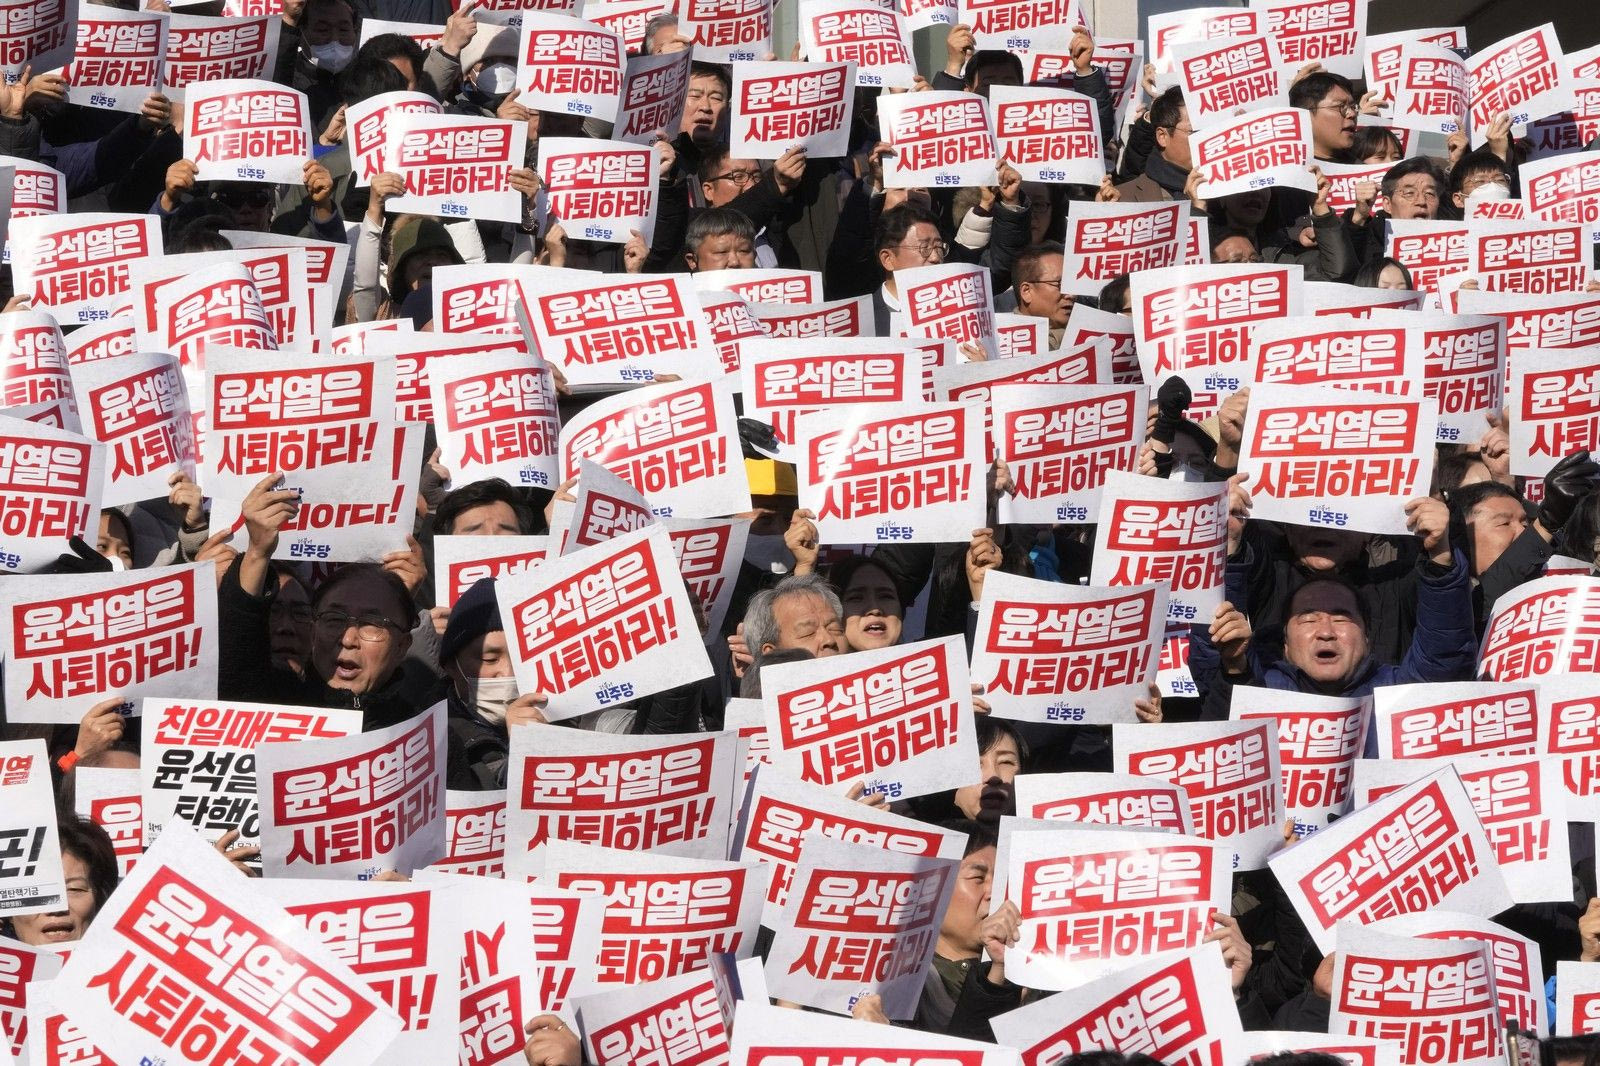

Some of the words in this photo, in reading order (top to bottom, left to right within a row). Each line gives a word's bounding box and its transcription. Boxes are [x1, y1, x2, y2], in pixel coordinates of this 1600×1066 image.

[8, 1, 59, 33] 열은
[819, 13, 897, 42] 윤석열은
[972, 0, 1069, 34] 사퇴하라!
[1268, 2, 1350, 32] 윤석열은
[1, 23, 69, 65] 하라!
[77, 23, 157, 52] 윤석열은
[168, 25, 259, 58] 윤석열은
[534, 34, 618, 64] 윤석열은
[826, 42, 911, 66] 사퇴하라!
[1007, 39, 1031, 48] 민주당
[63, 60, 160, 86] 사퇴하라!
[528, 68, 623, 95] 사퇴하라!
[859, 76, 882, 84] 민주당
[1189, 43, 1265, 85] 윤석열은
[90, 94, 116, 107] 민주당
[567, 102, 592, 114] 민주당
[748, 71, 841, 110] 윤석열은
[1199, 71, 1279, 115] 사퇴하라!
[1407, 92, 1468, 116] 사퇴하
[198, 94, 299, 130] 윤석열은
[745, 104, 846, 142] 사퇴하라!
[895, 100, 985, 138] 윤석열은
[1003, 101, 1092, 130] 윤석열은
[1441, 123, 1459, 132] 민주
[1513, 113, 1529, 124] 주당
[196, 129, 307, 162] 사퇴하라!
[403, 129, 504, 162] 윤석열은
[897, 135, 995, 171] 사퇴하라!
[1001, 135, 1099, 165] 사퇴하라!
[1202, 115, 1296, 158] 윤석열은
[237, 167, 265, 179] 민주당
[405, 165, 512, 195] 사퇴하라!
[551, 154, 648, 187] 윤석열은
[935, 176, 960, 184] 민주당
[1039, 171, 1065, 180] 민주당
[1207, 144, 1307, 184] 사퇴하라!
[1250, 177, 1275, 188] 민주당
[13, 174, 54, 206] 열은
[551, 190, 650, 220] 사퇴하라!
[442, 203, 468, 216] 민주당
[586, 227, 612, 239] 민주당
[1080, 210, 1173, 248] 윤석열은
[1399, 234, 1468, 262] 윤석열
[34, 224, 141, 274] 윤석열은
[1484, 232, 1576, 265] 윤석열은
[31, 263, 131, 308] 사퇴하
[1486, 266, 1585, 293] 사퇴하라!
[78, 310, 109, 321] 민주당
[175, 284, 267, 338] 윤석열
[448, 282, 520, 331] 윤석
[548, 283, 674, 330] 윤석열은
[1150, 276, 1280, 334] 윤석열은
[564, 320, 697, 367] 사퇴하라!
[1000, 329, 1031, 358] 열은
[1508, 307, 1600, 348] 석열은
[1155, 326, 1251, 377] 사퇴하
[1261, 334, 1397, 383] 윤석열은
[1424, 329, 1495, 372] 석열은
[620, 368, 654, 381] 민주당
[764, 358, 895, 401] 윤석열은
[1205, 378, 1240, 390] 민주당
[1531, 371, 1600, 415] 윤석
[218, 370, 363, 421] 윤석열은
[1424, 373, 1500, 415] 퇴하라!
[570, 391, 702, 463] 윤석열은
[1013, 403, 1128, 454] 윤석열은
[1260, 409, 1407, 455] 윤석열은
[1436, 428, 1460, 441] 주당
[217, 422, 378, 475] 사퇴하라!
[817, 416, 958, 477] 윤석열은
[519, 470, 548, 485] 민주당
[818, 463, 971, 523] 사퇴하라!
[1251, 458, 1420, 499] 사퇴하라!
[2, 498, 91, 539] 하라!
[875, 526, 915, 540] 민주당
[1056, 507, 1087, 521] 민주당
[1309, 509, 1349, 527] 민주당
[290, 544, 331, 558] 민주당
[23, 578, 185, 650] 윤석열은
[521, 552, 648, 651] 윤석열은
[999, 600, 1145, 646] 윤석열은
[25, 627, 202, 701] 사퇴하라!
[535, 597, 678, 695] 사퇴하라!
[986, 643, 1152, 696] 사퇴하라!
[1171, 681, 1197, 694] 민주
[595, 682, 634, 704] 민주당
[788, 654, 940, 739] 윤석열은
[1046, 706, 1086, 721] 민주당
[1401, 697, 1533, 758] 윤석열은
[800, 703, 959, 786] 사퇴하라!
[1278, 712, 1361, 758] 석열은
[283, 726, 430, 814] 윤석열은
[533, 747, 702, 804] 윤석열은
[285, 773, 439, 866] 사퇴하라!
[1189, 782, 1276, 840] 퇴하라!
[1311, 792, 1449, 919] 윤석열은
[1031, 851, 1202, 912] 윤석열은
[1357, 832, 1480, 925] 퇴하라!
[807, 874, 941, 926] 윤석열은
[299, 901, 413, 967] 열은
[132, 882, 352, 1048] 윤석열은
[597, 931, 743, 985] 퇴하라!
[1346, 956, 1489, 1010] 윤석열은
